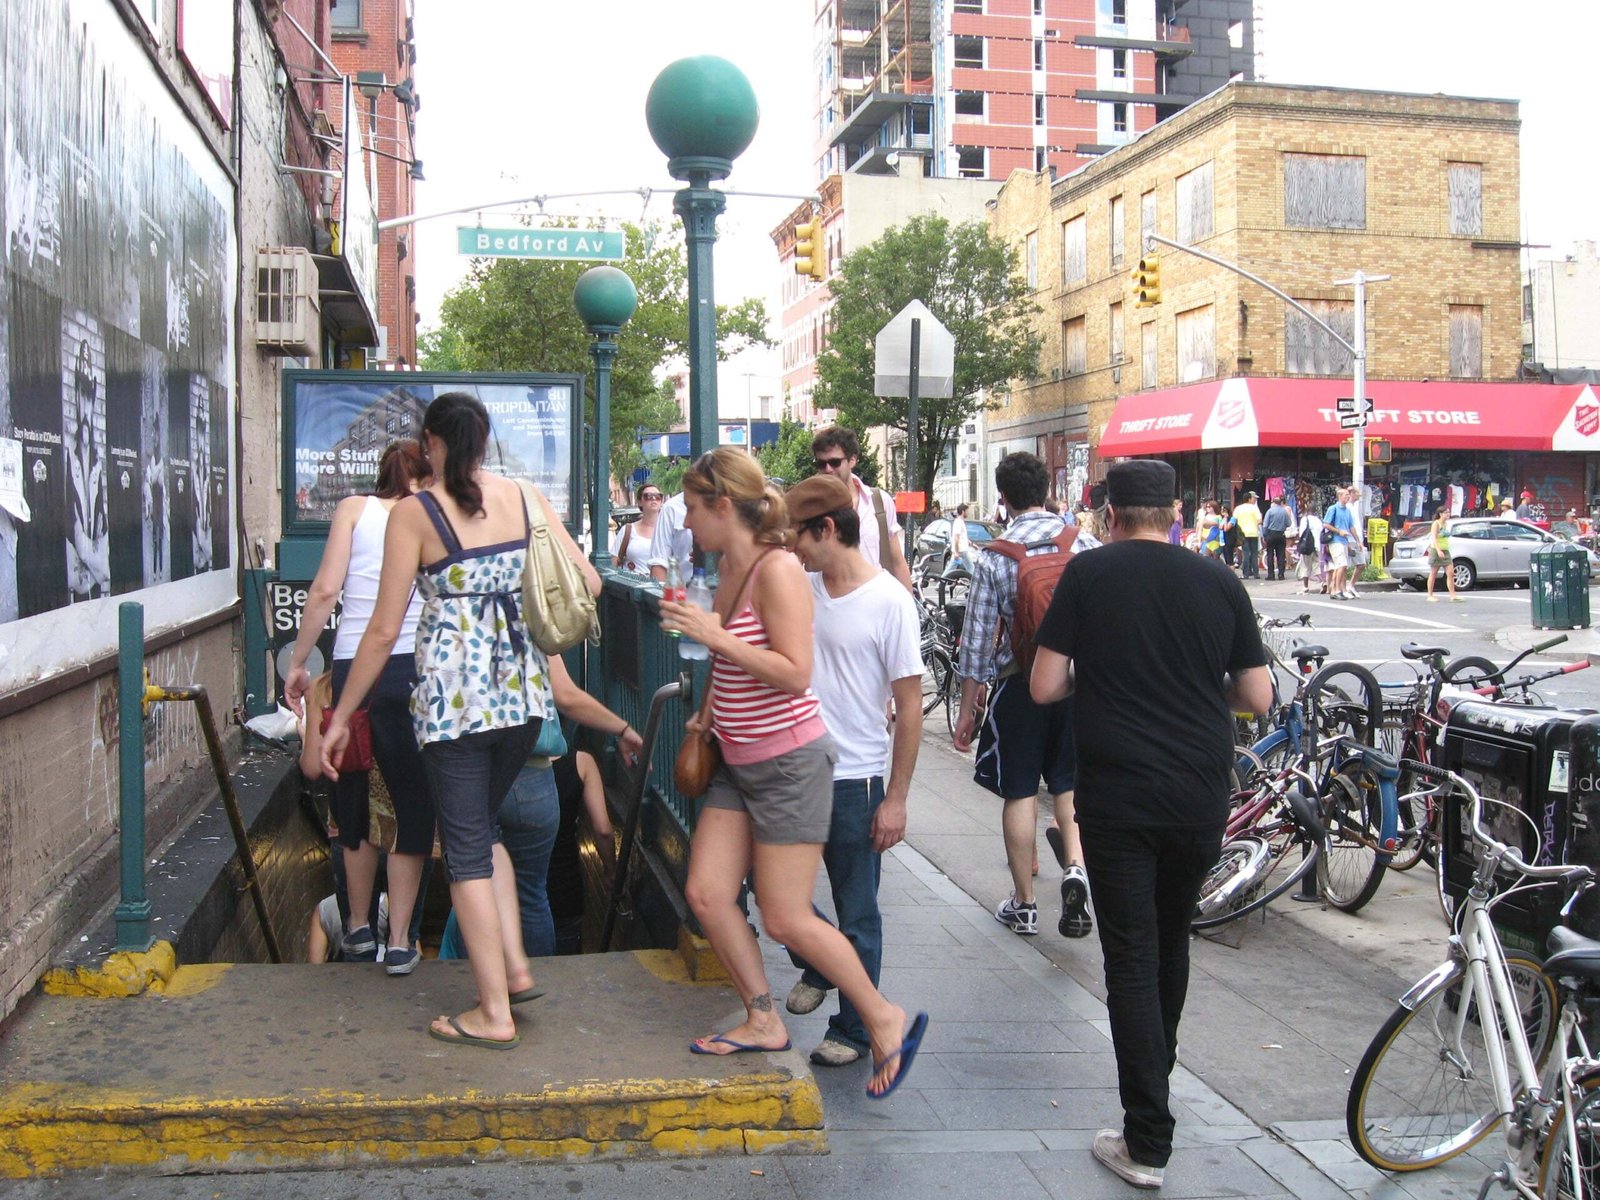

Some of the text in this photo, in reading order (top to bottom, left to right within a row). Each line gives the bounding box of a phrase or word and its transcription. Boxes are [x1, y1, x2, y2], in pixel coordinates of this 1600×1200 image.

[477, 234, 604, 252] Bedford Av
[483, 400, 566, 413] TROPOLITAN
[1120, 413, 1193, 434] THRIFT STORE
[1407, 410, 1481, 424] STORE
[296, 448, 335, 461] More
[296, 462, 335, 474] More
